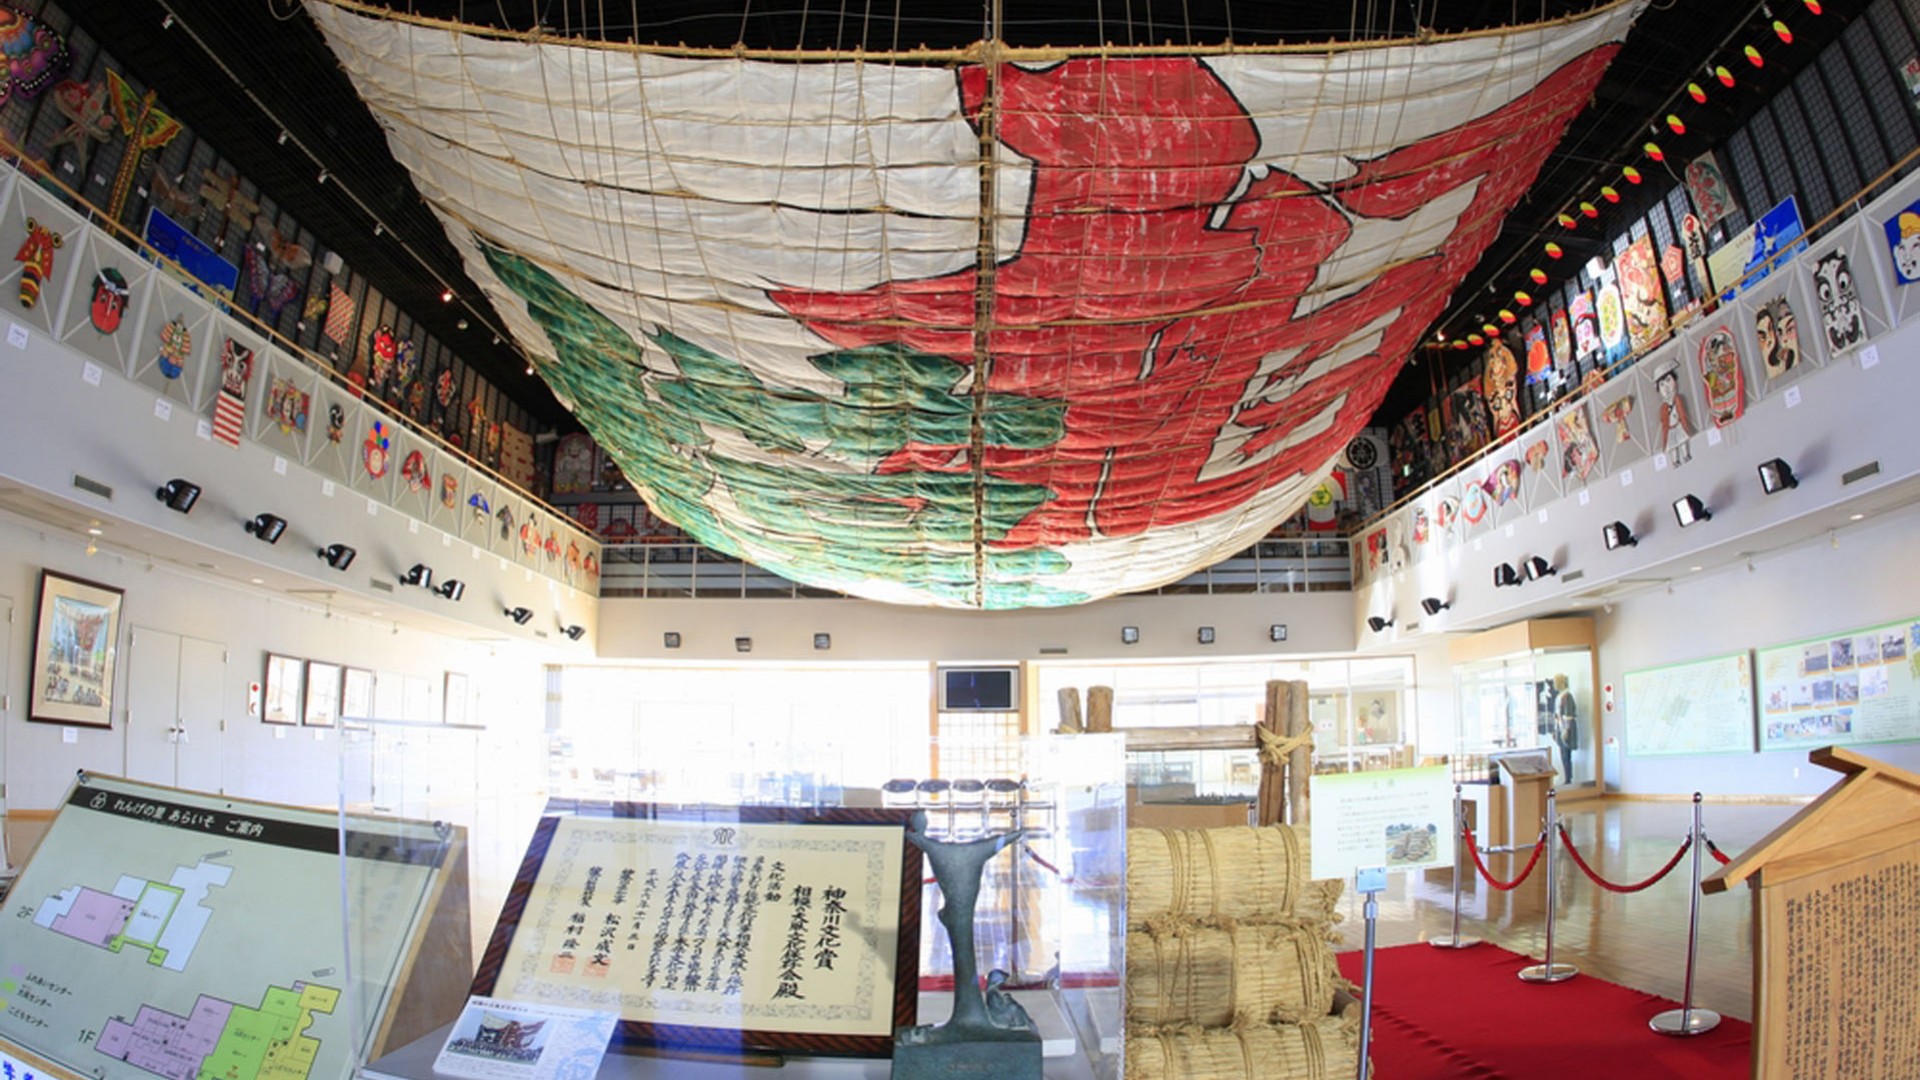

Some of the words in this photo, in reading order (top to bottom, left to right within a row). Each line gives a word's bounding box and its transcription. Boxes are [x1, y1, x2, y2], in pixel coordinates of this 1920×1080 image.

[113, 798, 165, 819] れんげの里
[168, 809, 215, 829] あらいそ
[225, 819, 264, 837] ご案内
[16, 905, 34, 919] 2F
[814, 885, 848, 971] 神奈川文化賞
[78, 1028, 96, 1045] 1F
